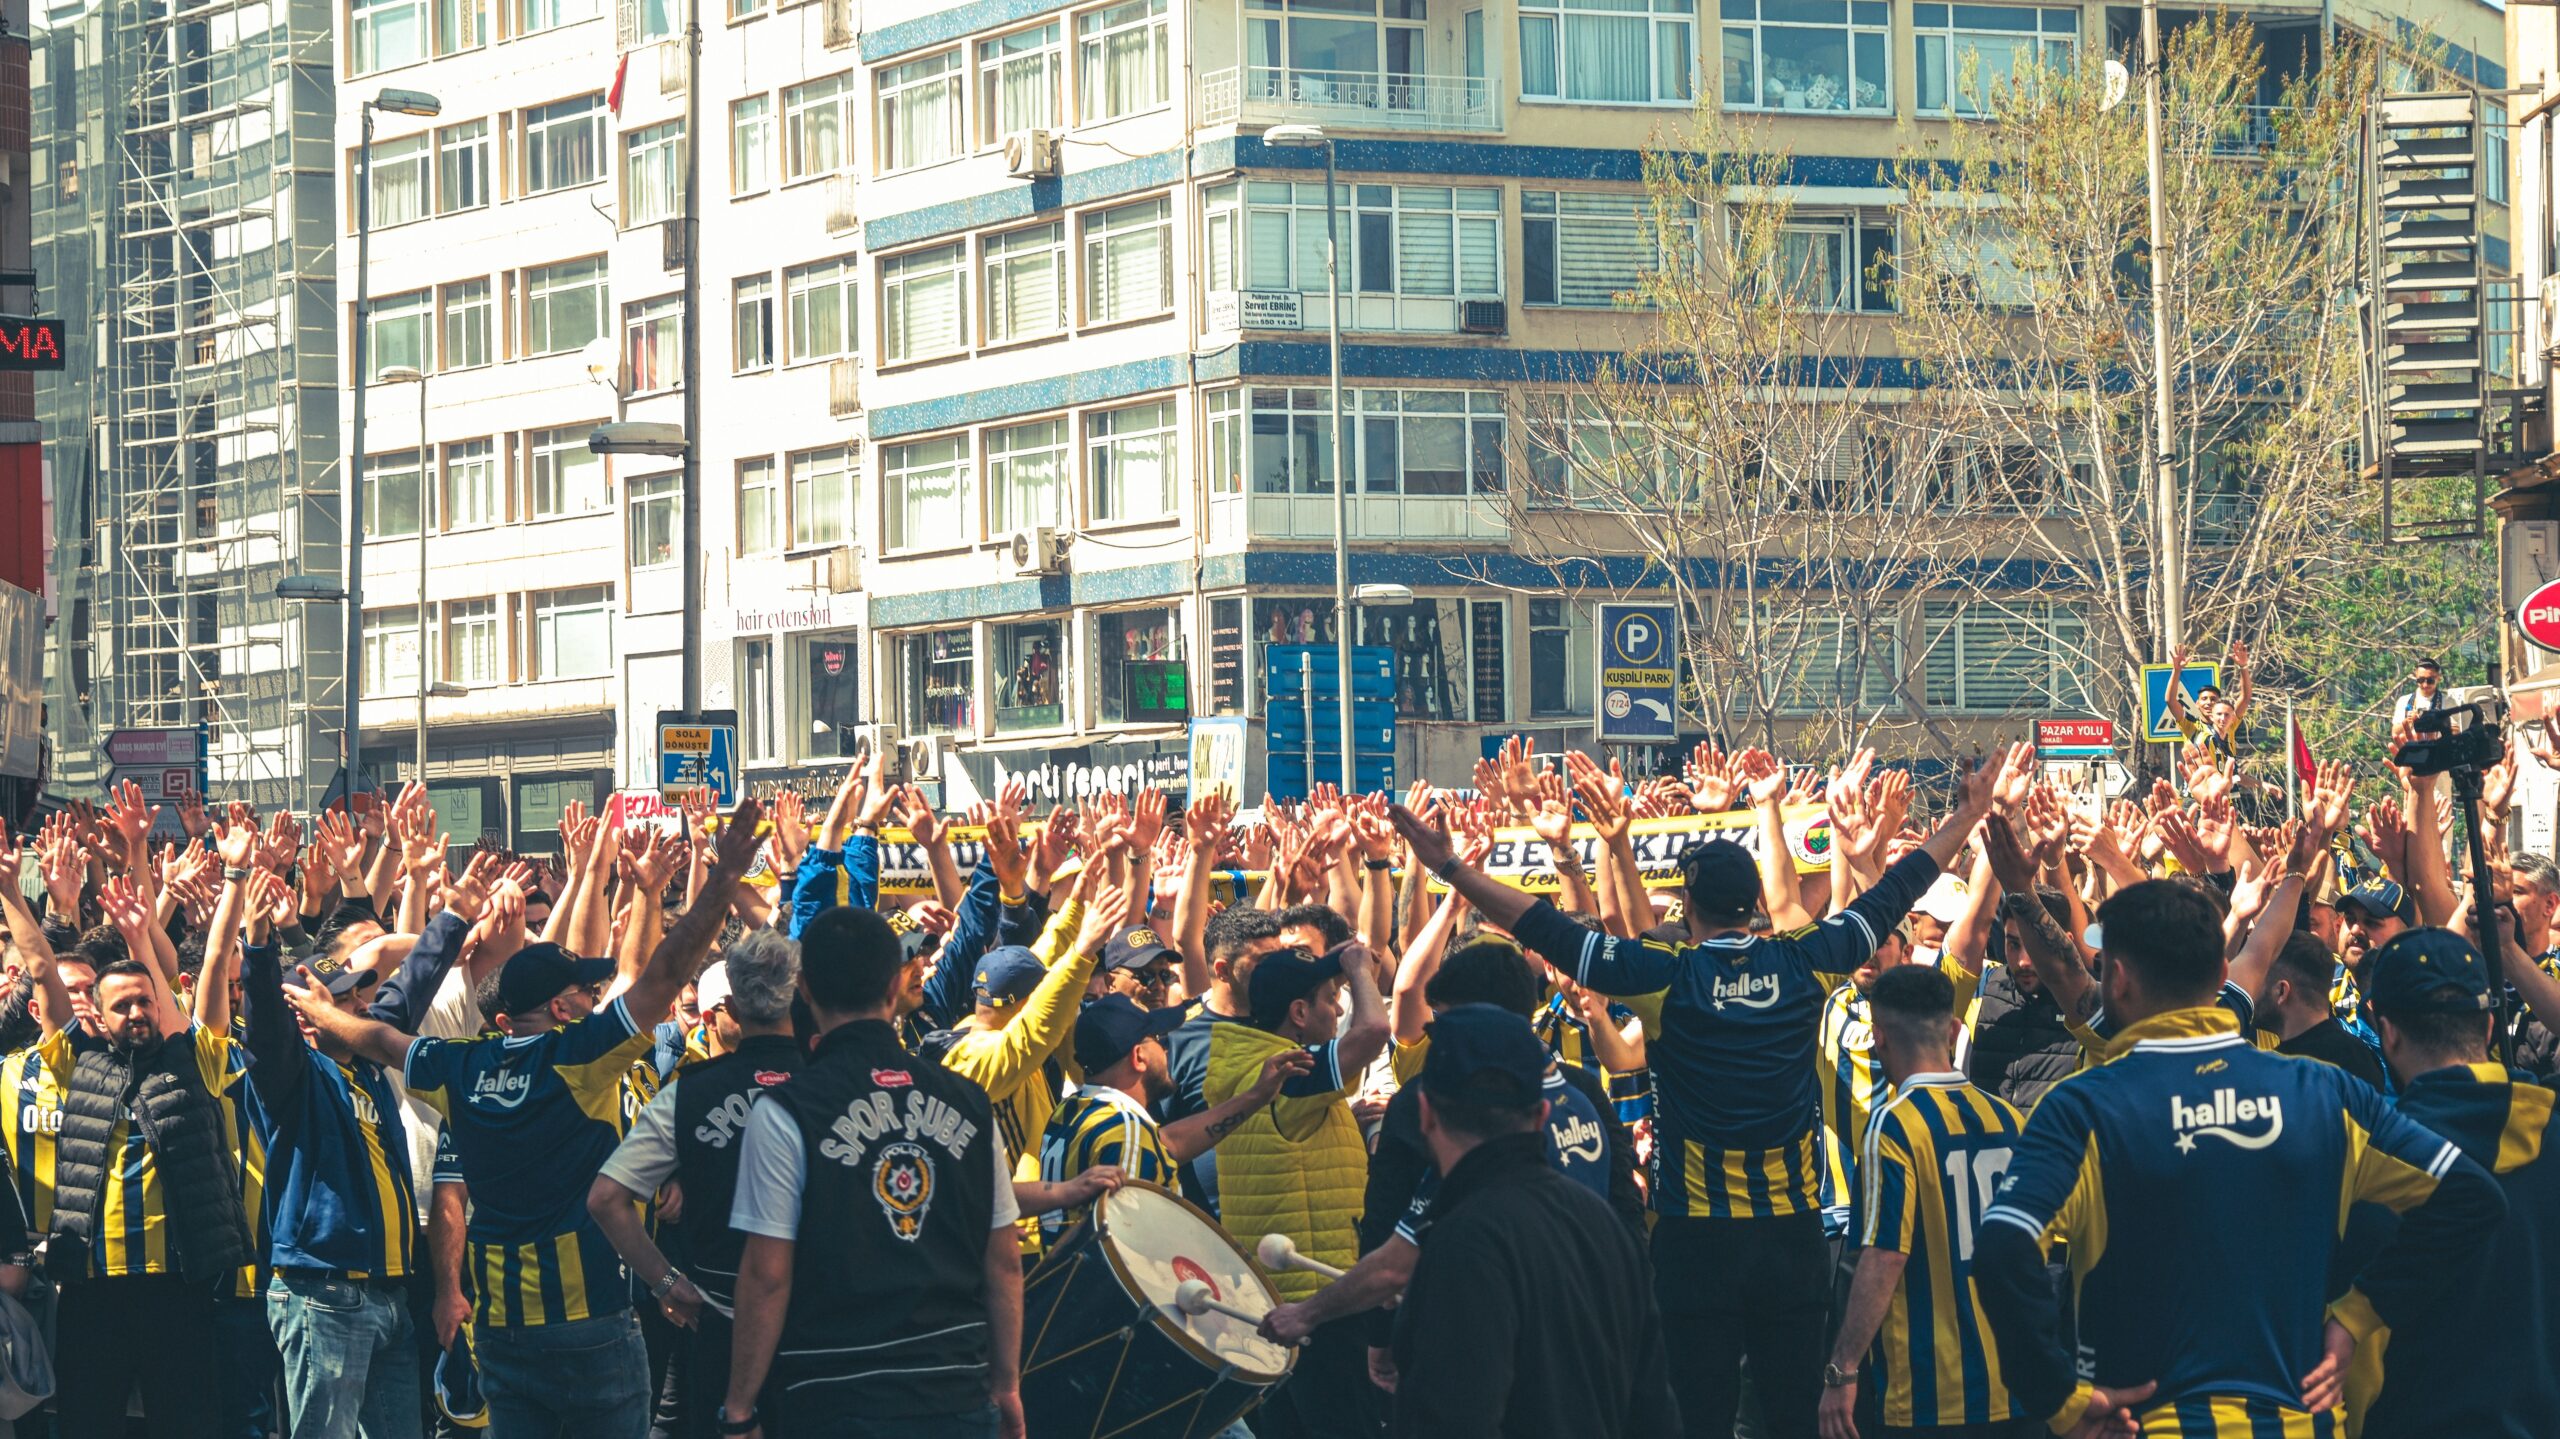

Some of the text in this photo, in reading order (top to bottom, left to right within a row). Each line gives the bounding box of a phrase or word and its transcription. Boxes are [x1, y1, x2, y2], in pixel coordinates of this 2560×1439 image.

[1245, 301, 1268, 310] Servet
[737, 609, 763, 631] hair
[1606, 670, 1670, 685] KUŞDİLİ PARK
[1611, 700, 1630, 708] 7/24
[676, 730, 701, 738] SOLA
[2040, 726, 2104, 736] PAZAR YOLU
[665, 741, 709, 750] DÖNÜŞTE
[1713, 973, 1780, 1008] halley
[474, 1069, 530, 1107] halley
[820, 1090, 978, 1166] SPOR ŞUBE
[2172, 1088, 2283, 1150] halley
[1551, 1115, 1603, 1162] halley
